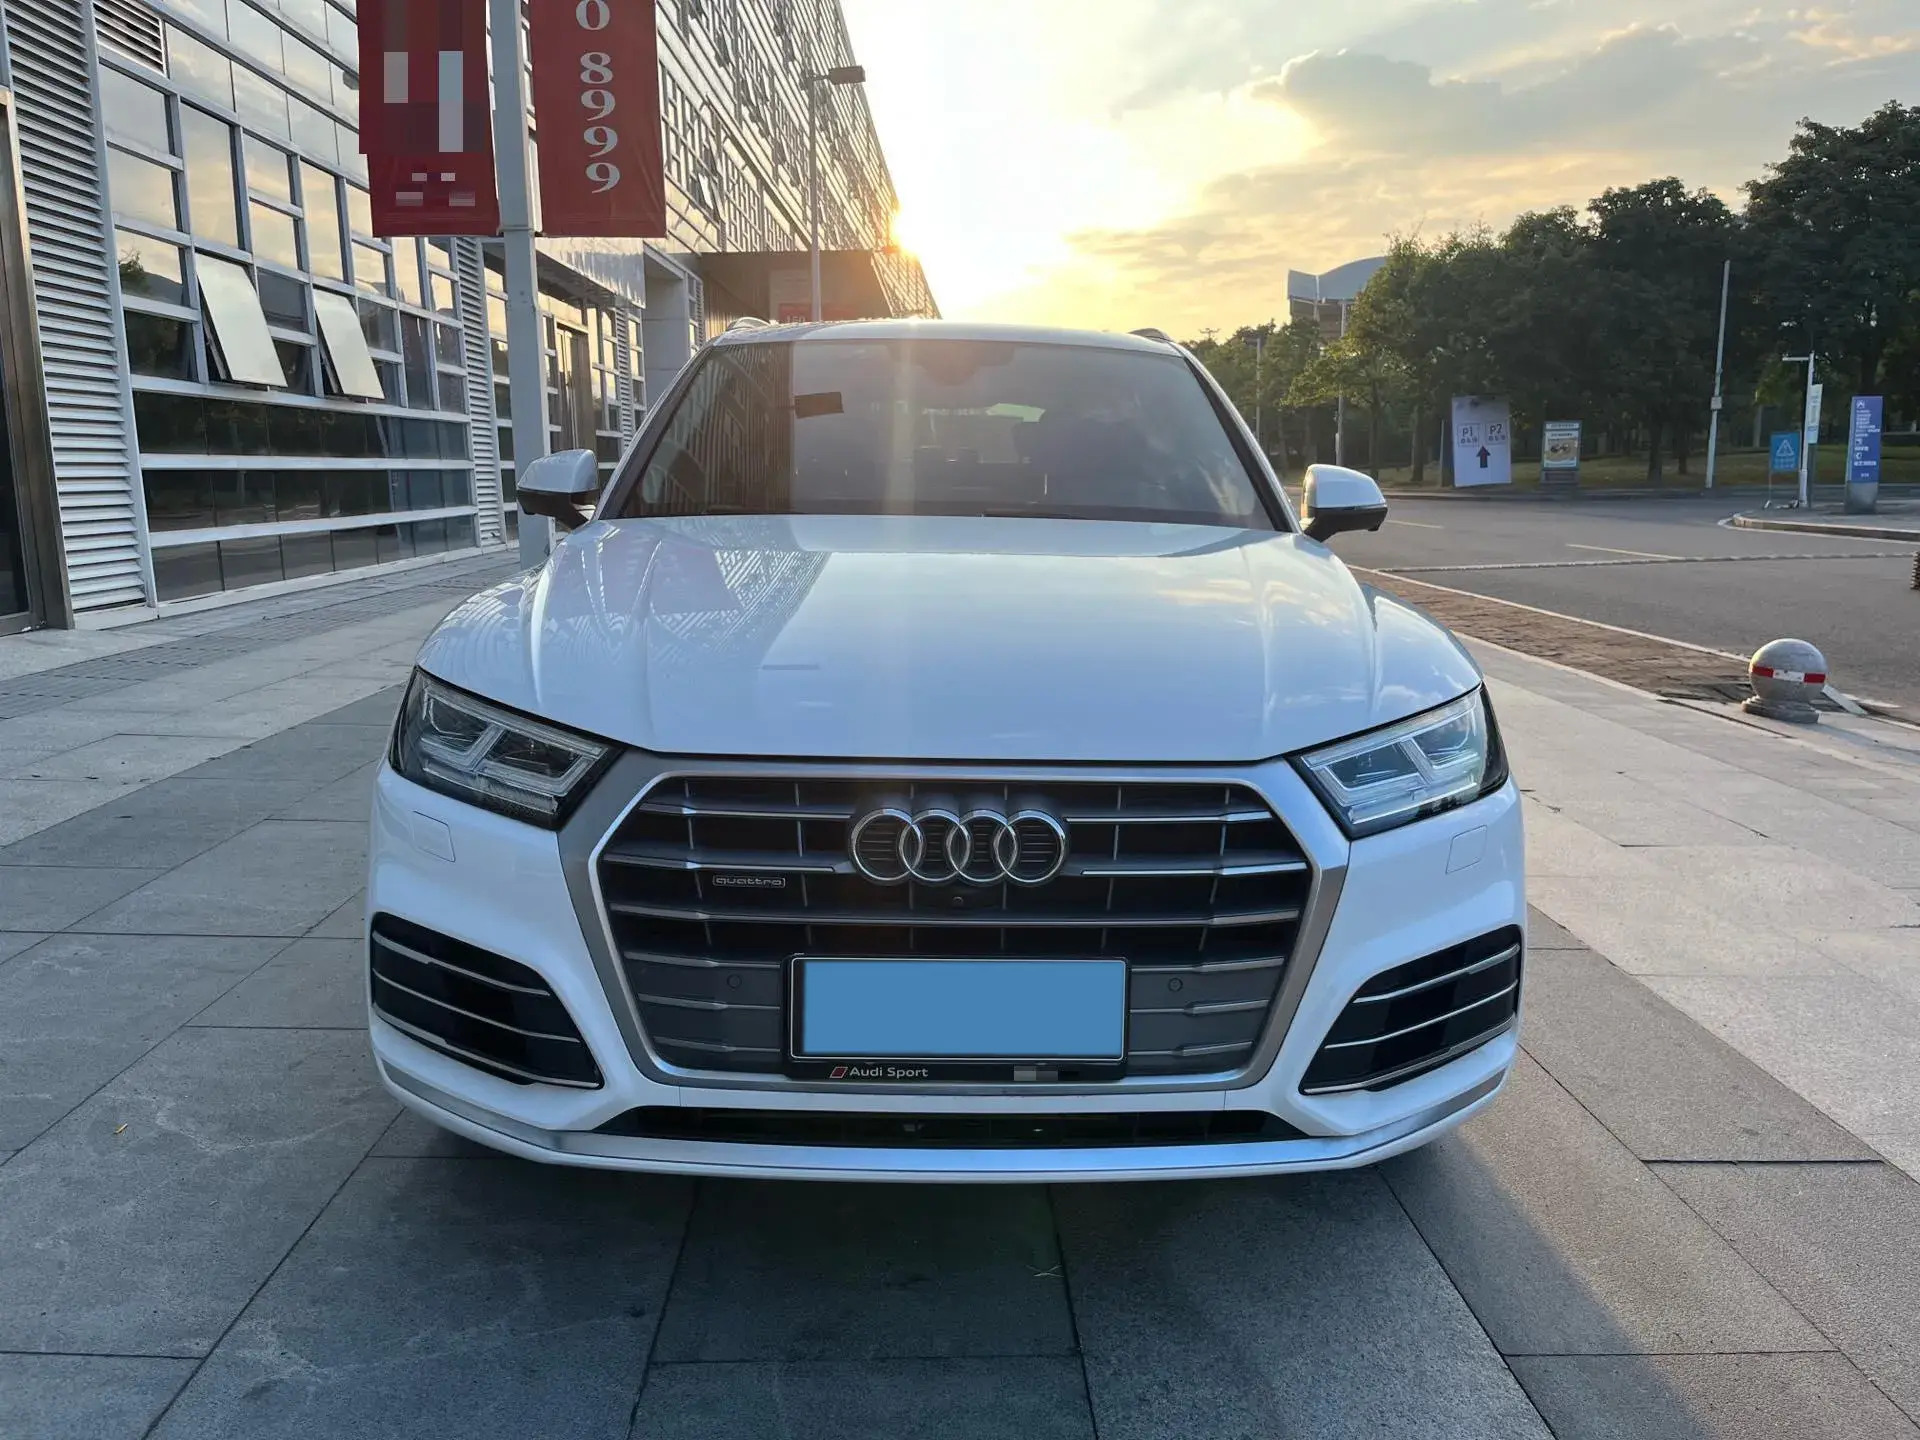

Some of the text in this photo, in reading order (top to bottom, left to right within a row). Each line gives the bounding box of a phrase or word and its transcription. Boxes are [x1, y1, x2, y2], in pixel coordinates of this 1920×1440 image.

[580, 51, 621, 194] 8999
[1462, 426, 1473, 437] P1
[715, 876, 783, 887] quattro
[849, 1066, 929, 1079] Audi Sport
